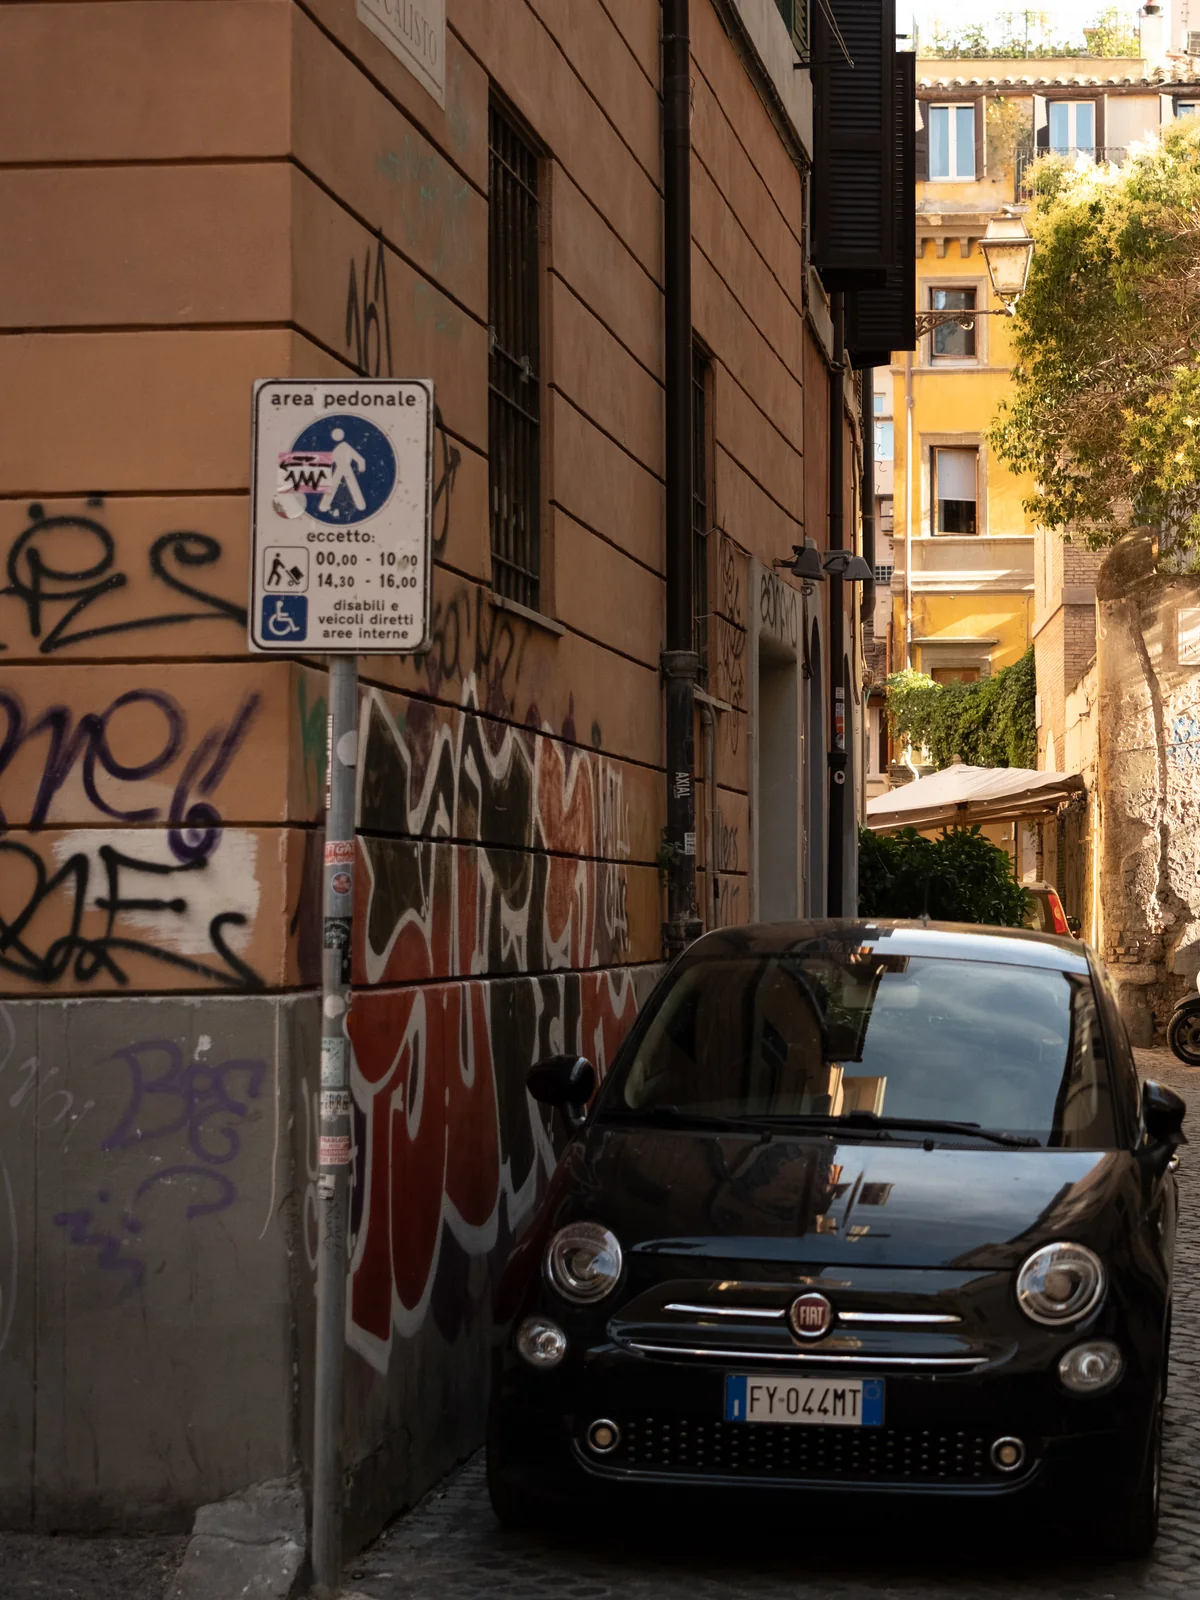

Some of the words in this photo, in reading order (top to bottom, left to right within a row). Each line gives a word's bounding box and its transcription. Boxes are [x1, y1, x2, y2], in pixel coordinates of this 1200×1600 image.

[271, 393, 315, 406] area
[324, 391, 416, 408] pedonale
[307, 529, 376, 543] eccetto:
[333, 599, 385, 611] disabili
[391, 602, 400, 611] e
[318, 613, 364, 625] veicoli
[370, 614, 414, 625] diretti
[323, 629, 353, 638] aree
[359, 627, 409, 639] interne
[1184, 645, 1197, 654] IN
[676, 772, 690, 798] AXIAL
[800, 1306, 824, 1325] FIAT
